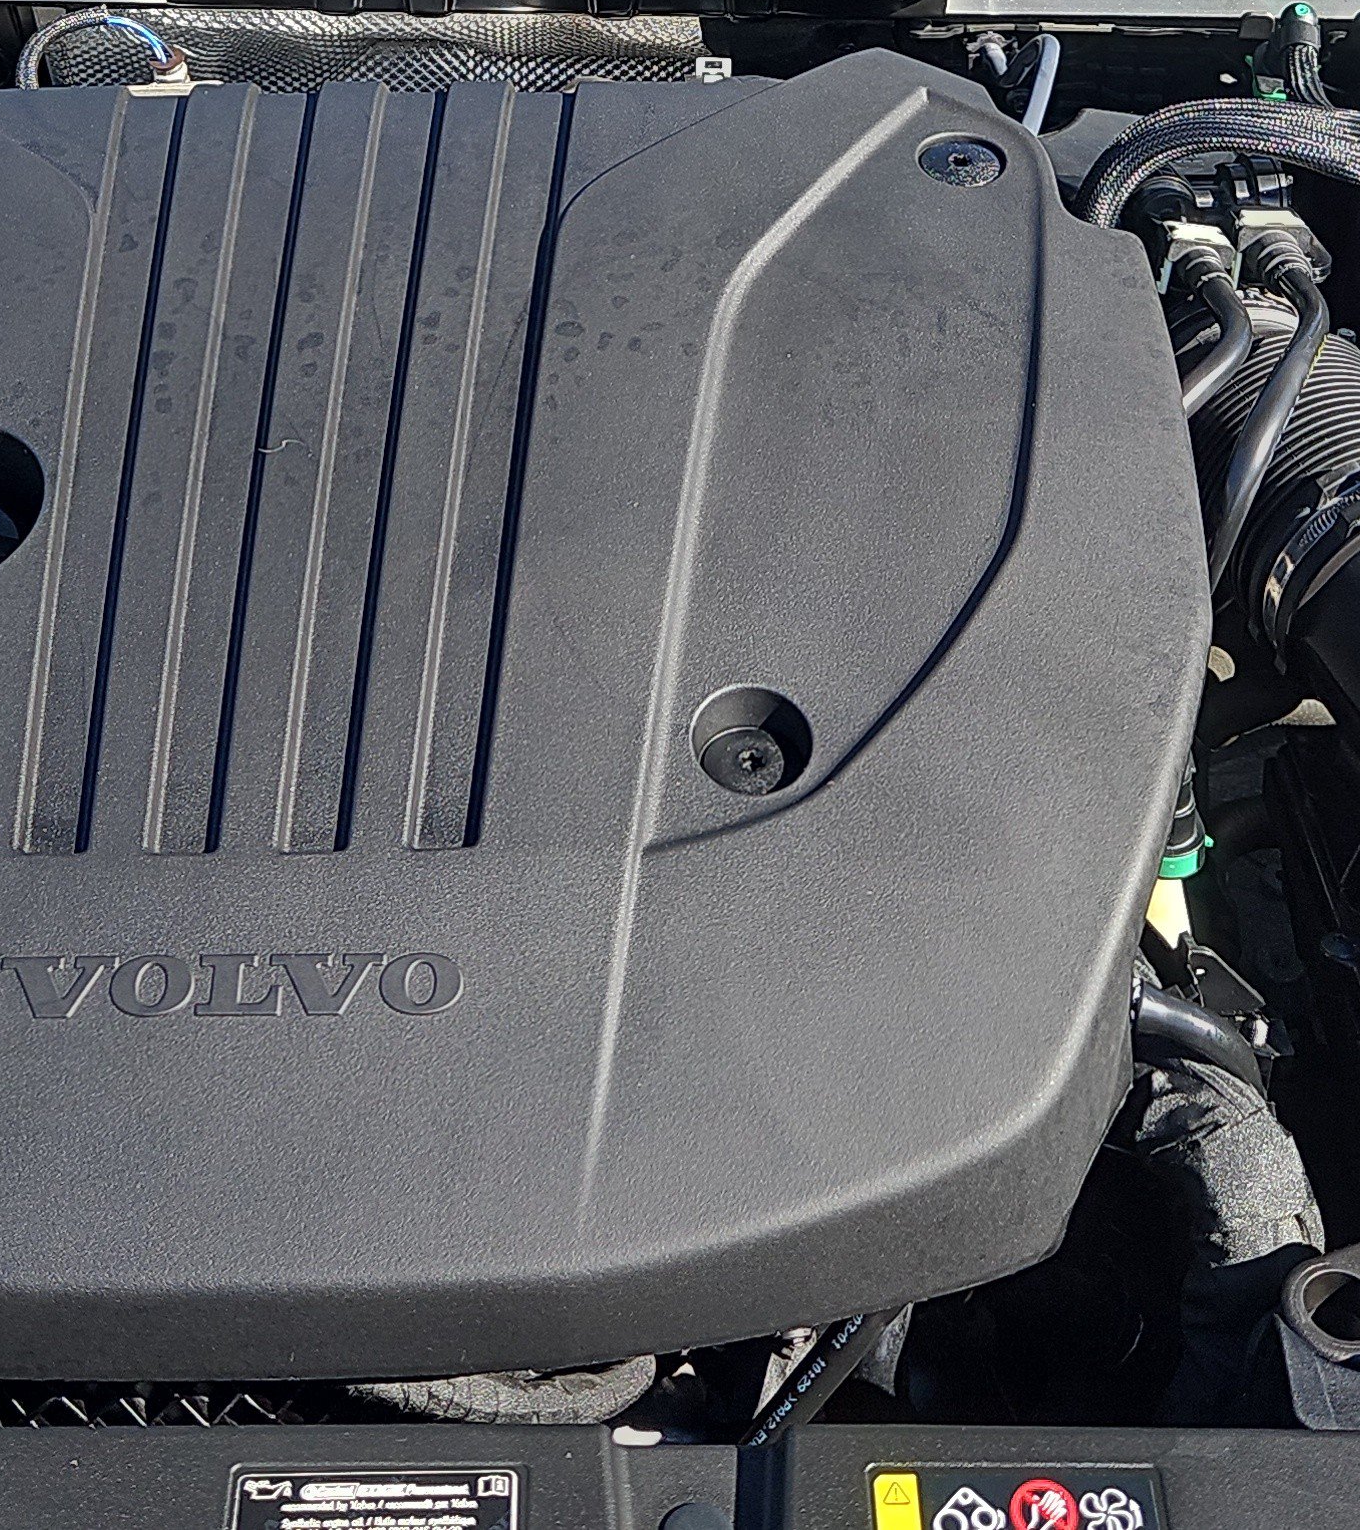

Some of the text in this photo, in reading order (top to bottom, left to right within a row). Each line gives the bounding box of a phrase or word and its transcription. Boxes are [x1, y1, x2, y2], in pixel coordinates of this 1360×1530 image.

[0, 951, 466, 1020] VOLVO
[796, 1356, 827, 1394] 10:29
[350, 1500, 376, 1510] Volvo
[451, 1498, 478, 1508] Volvo
